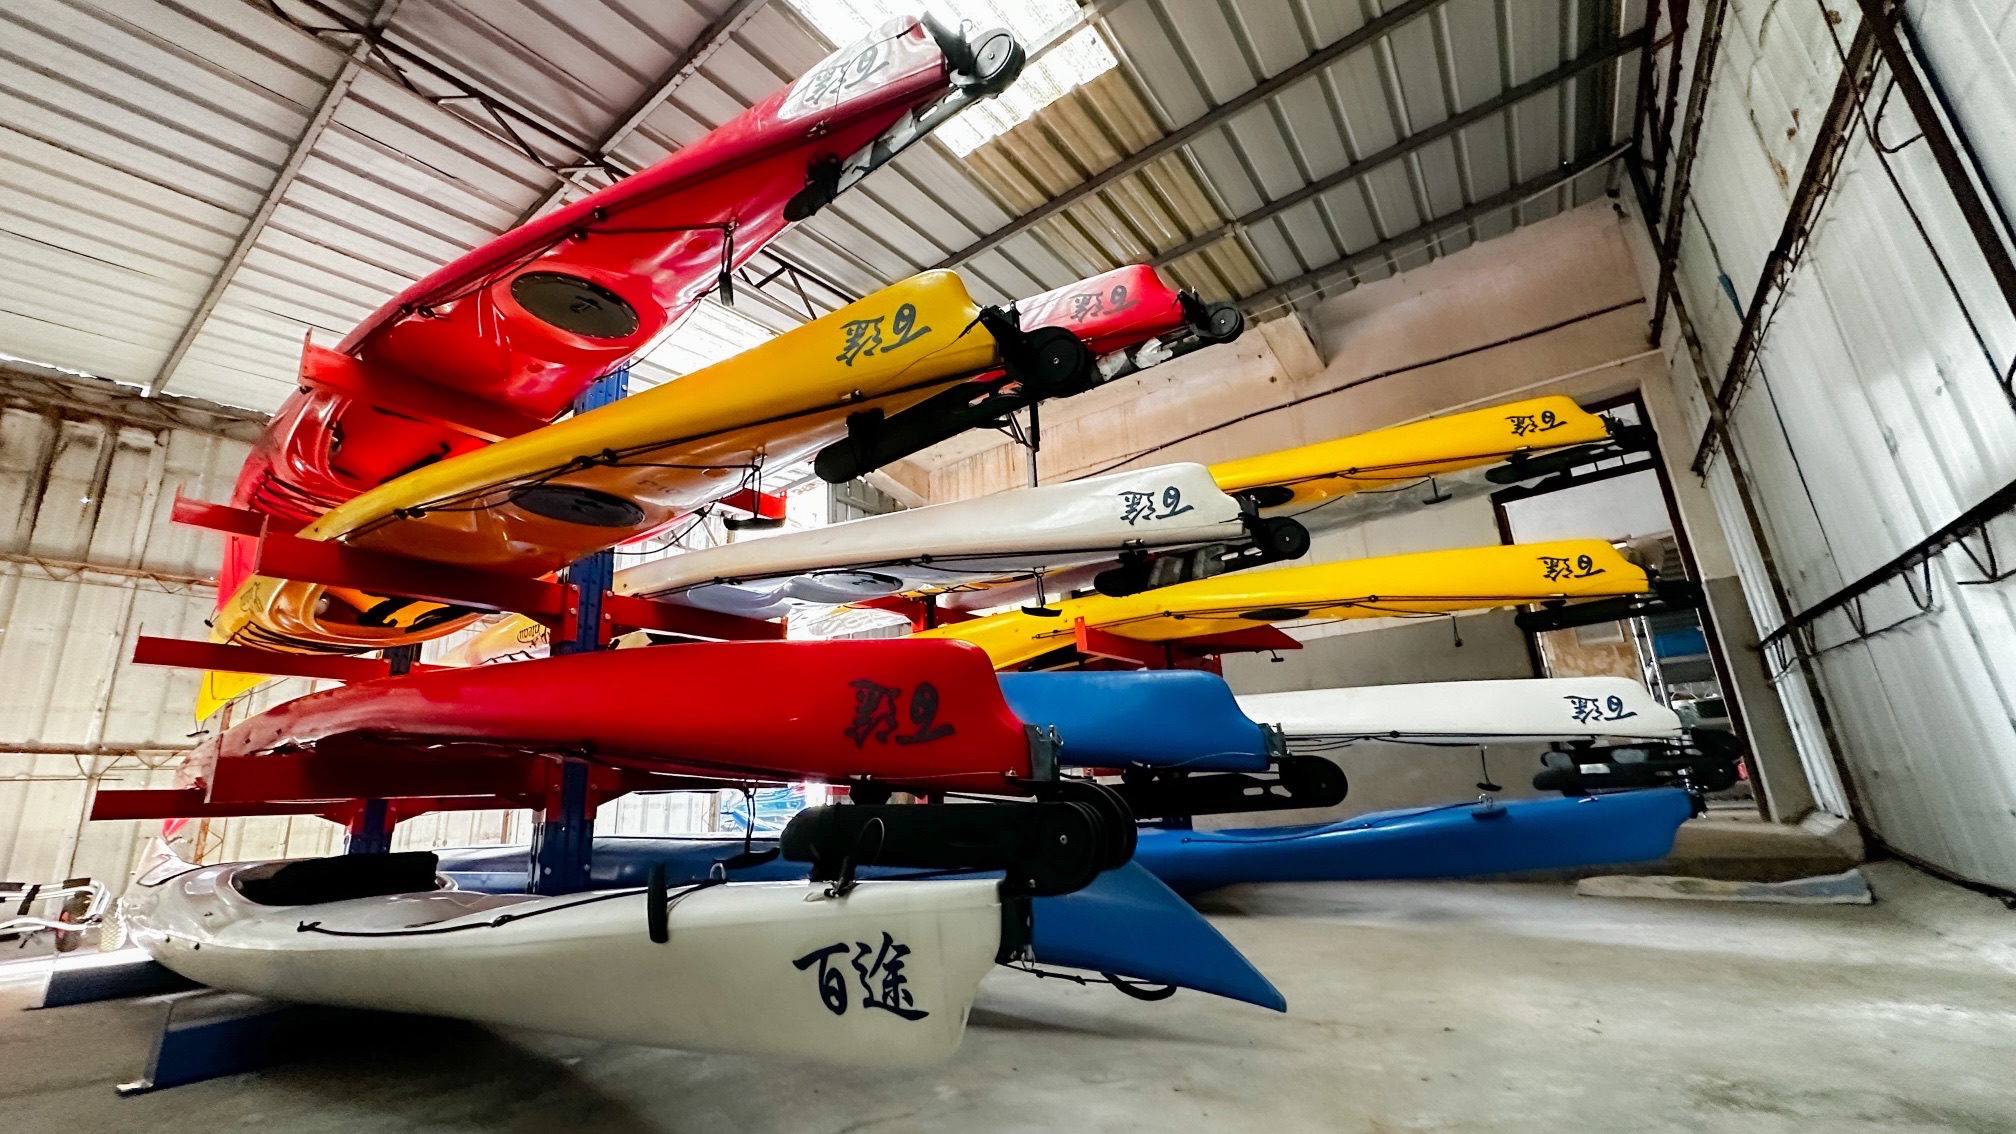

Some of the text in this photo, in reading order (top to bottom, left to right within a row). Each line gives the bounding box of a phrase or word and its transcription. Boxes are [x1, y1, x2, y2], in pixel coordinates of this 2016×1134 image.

[1069, 285, 1138, 323] 百途
[836, 303, 932, 366] 百途
[1504, 410, 1567, 436] 百途
[1118, 486, 1194, 525] 百途
[1537, 555, 1606, 582] 百途
[844, 679, 956, 750] 百途
[1563, 695, 1638, 725] 百途
[792, 931, 929, 1020] 百途
